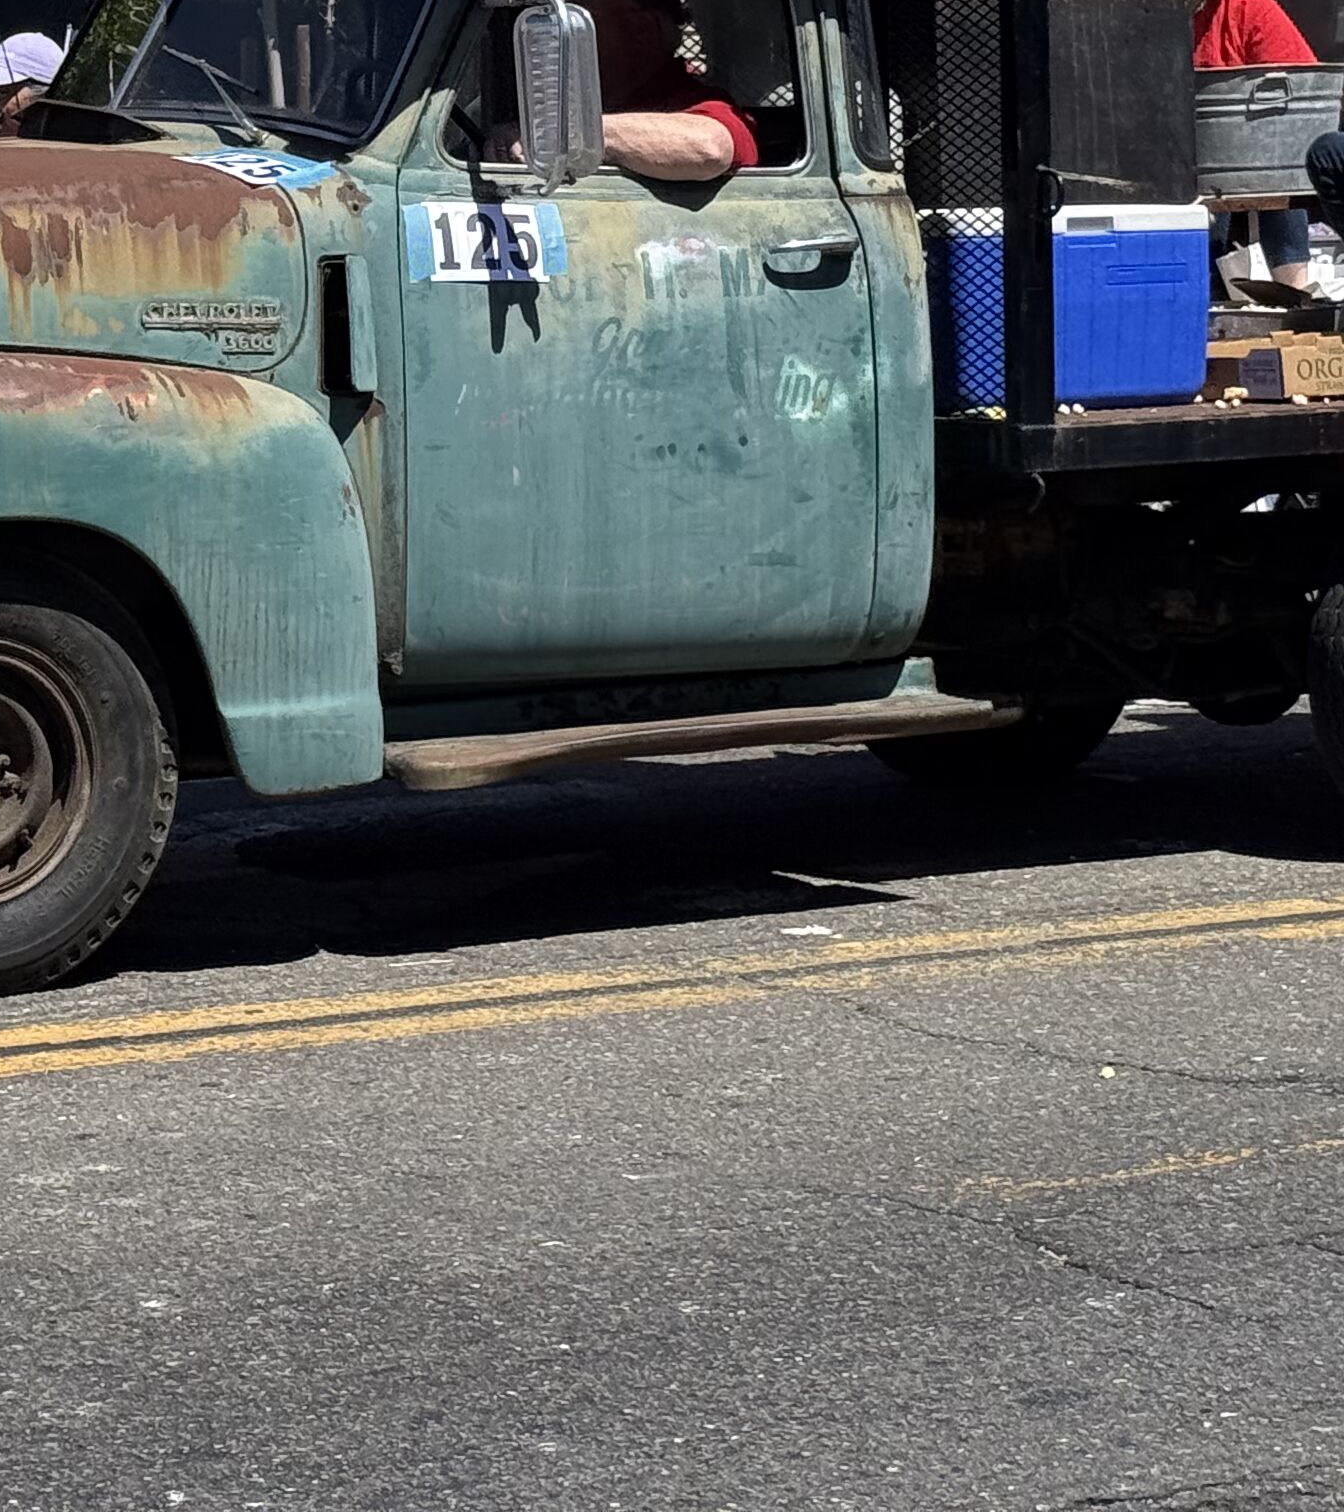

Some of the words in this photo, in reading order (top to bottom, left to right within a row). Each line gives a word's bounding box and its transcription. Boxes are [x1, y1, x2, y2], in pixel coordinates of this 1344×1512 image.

[434, 212, 539, 271] 125
[147, 301, 279, 321] CHEVROLET
[223, 331, 275, 350] 3600
